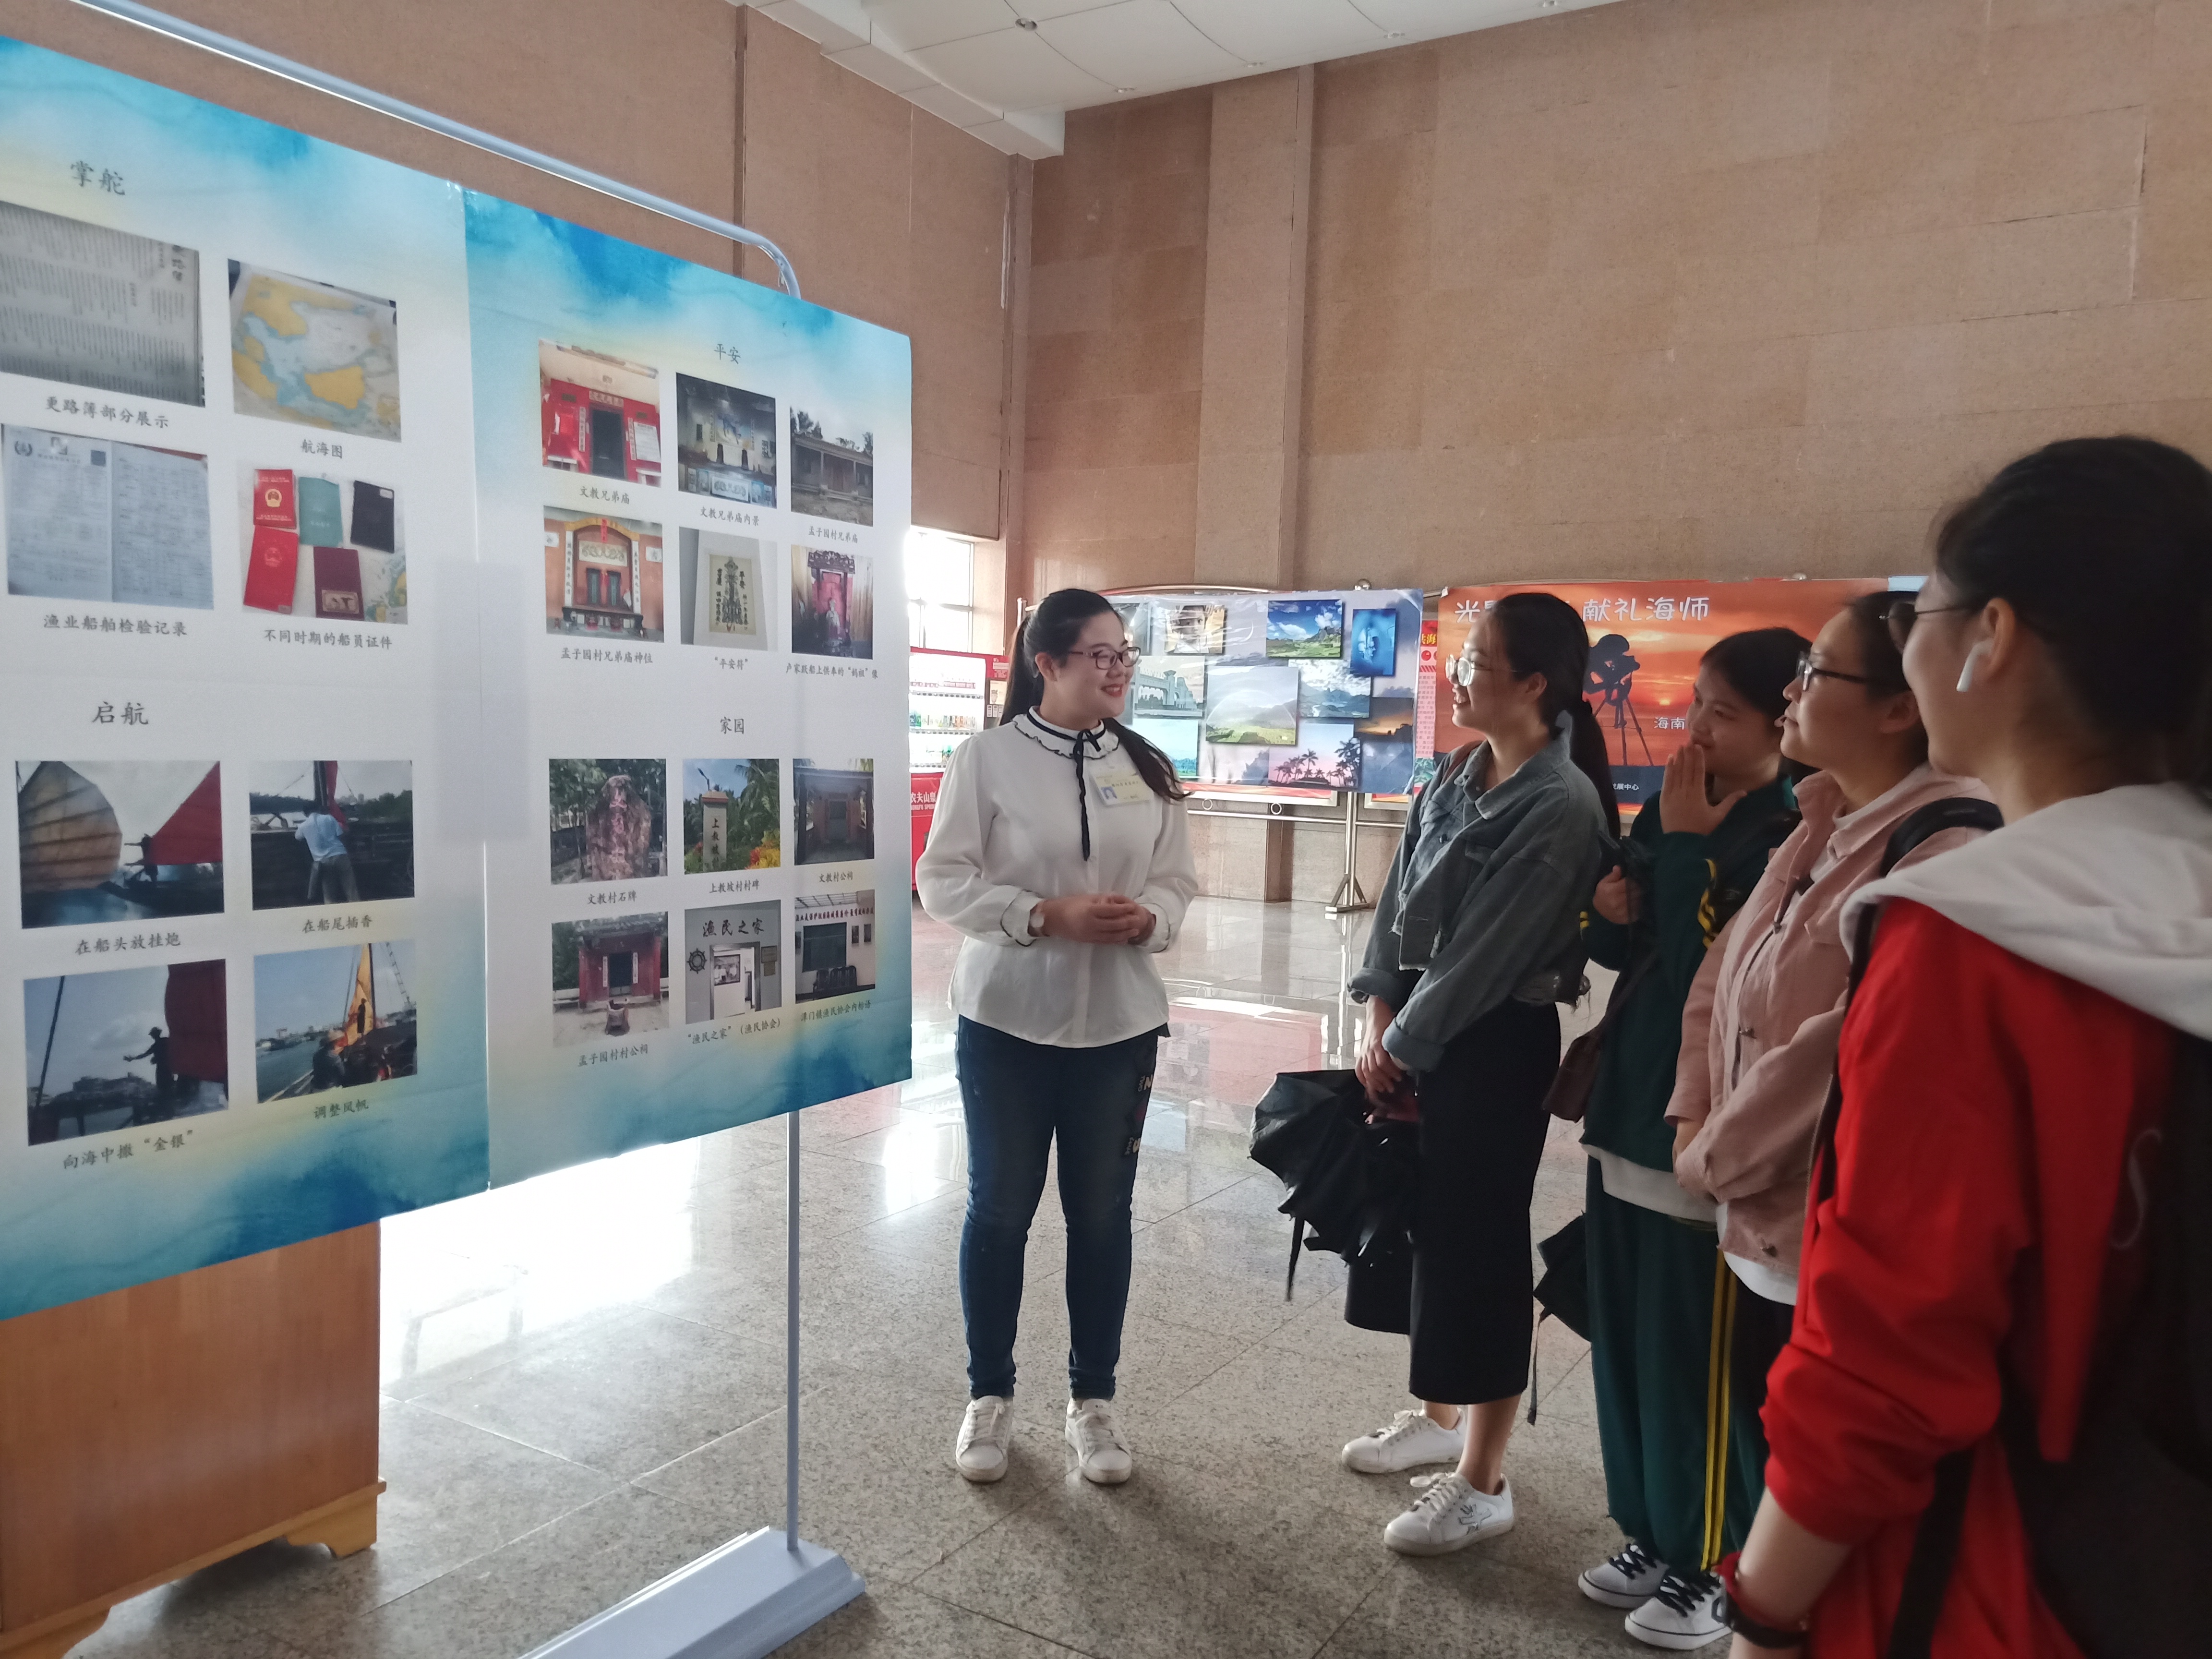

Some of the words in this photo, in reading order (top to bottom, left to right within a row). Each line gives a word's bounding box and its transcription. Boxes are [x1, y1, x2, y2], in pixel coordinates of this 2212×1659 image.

[71, 161, 125, 195] 掌舵
[714, 344, 741, 364] 平安
[45, 396, 169, 429] 更路簿部分展示
[301, 439, 342, 458] 航海图
[580, 486, 630, 504] 文教兄弟庙
[700, 506, 760, 527] 文教兄弟庙内景
[1455, 600, 1494, 623] 光
[1583, 597, 1709, 621] 献礼海师
[44, 614, 187, 637] 渔业船舶检验记录
[264, 630, 392, 649] 不同时期的船员证件
[92, 701, 149, 725] 启航
[720, 717, 745, 734] 家园
[1654, 717, 1685, 730] 海南
[709, 879, 760, 893] 上教坡村村碑
[819, 871, 853, 883] 文教村公祠
[588, 890, 637, 905] 文教村石牌
[303, 915, 373, 933] 在船尾插香
[702, 918, 765, 938] 渔民之家
[75, 933, 181, 955] 在船头放挂炮
[314, 1099, 369, 1119] 调整风帆
